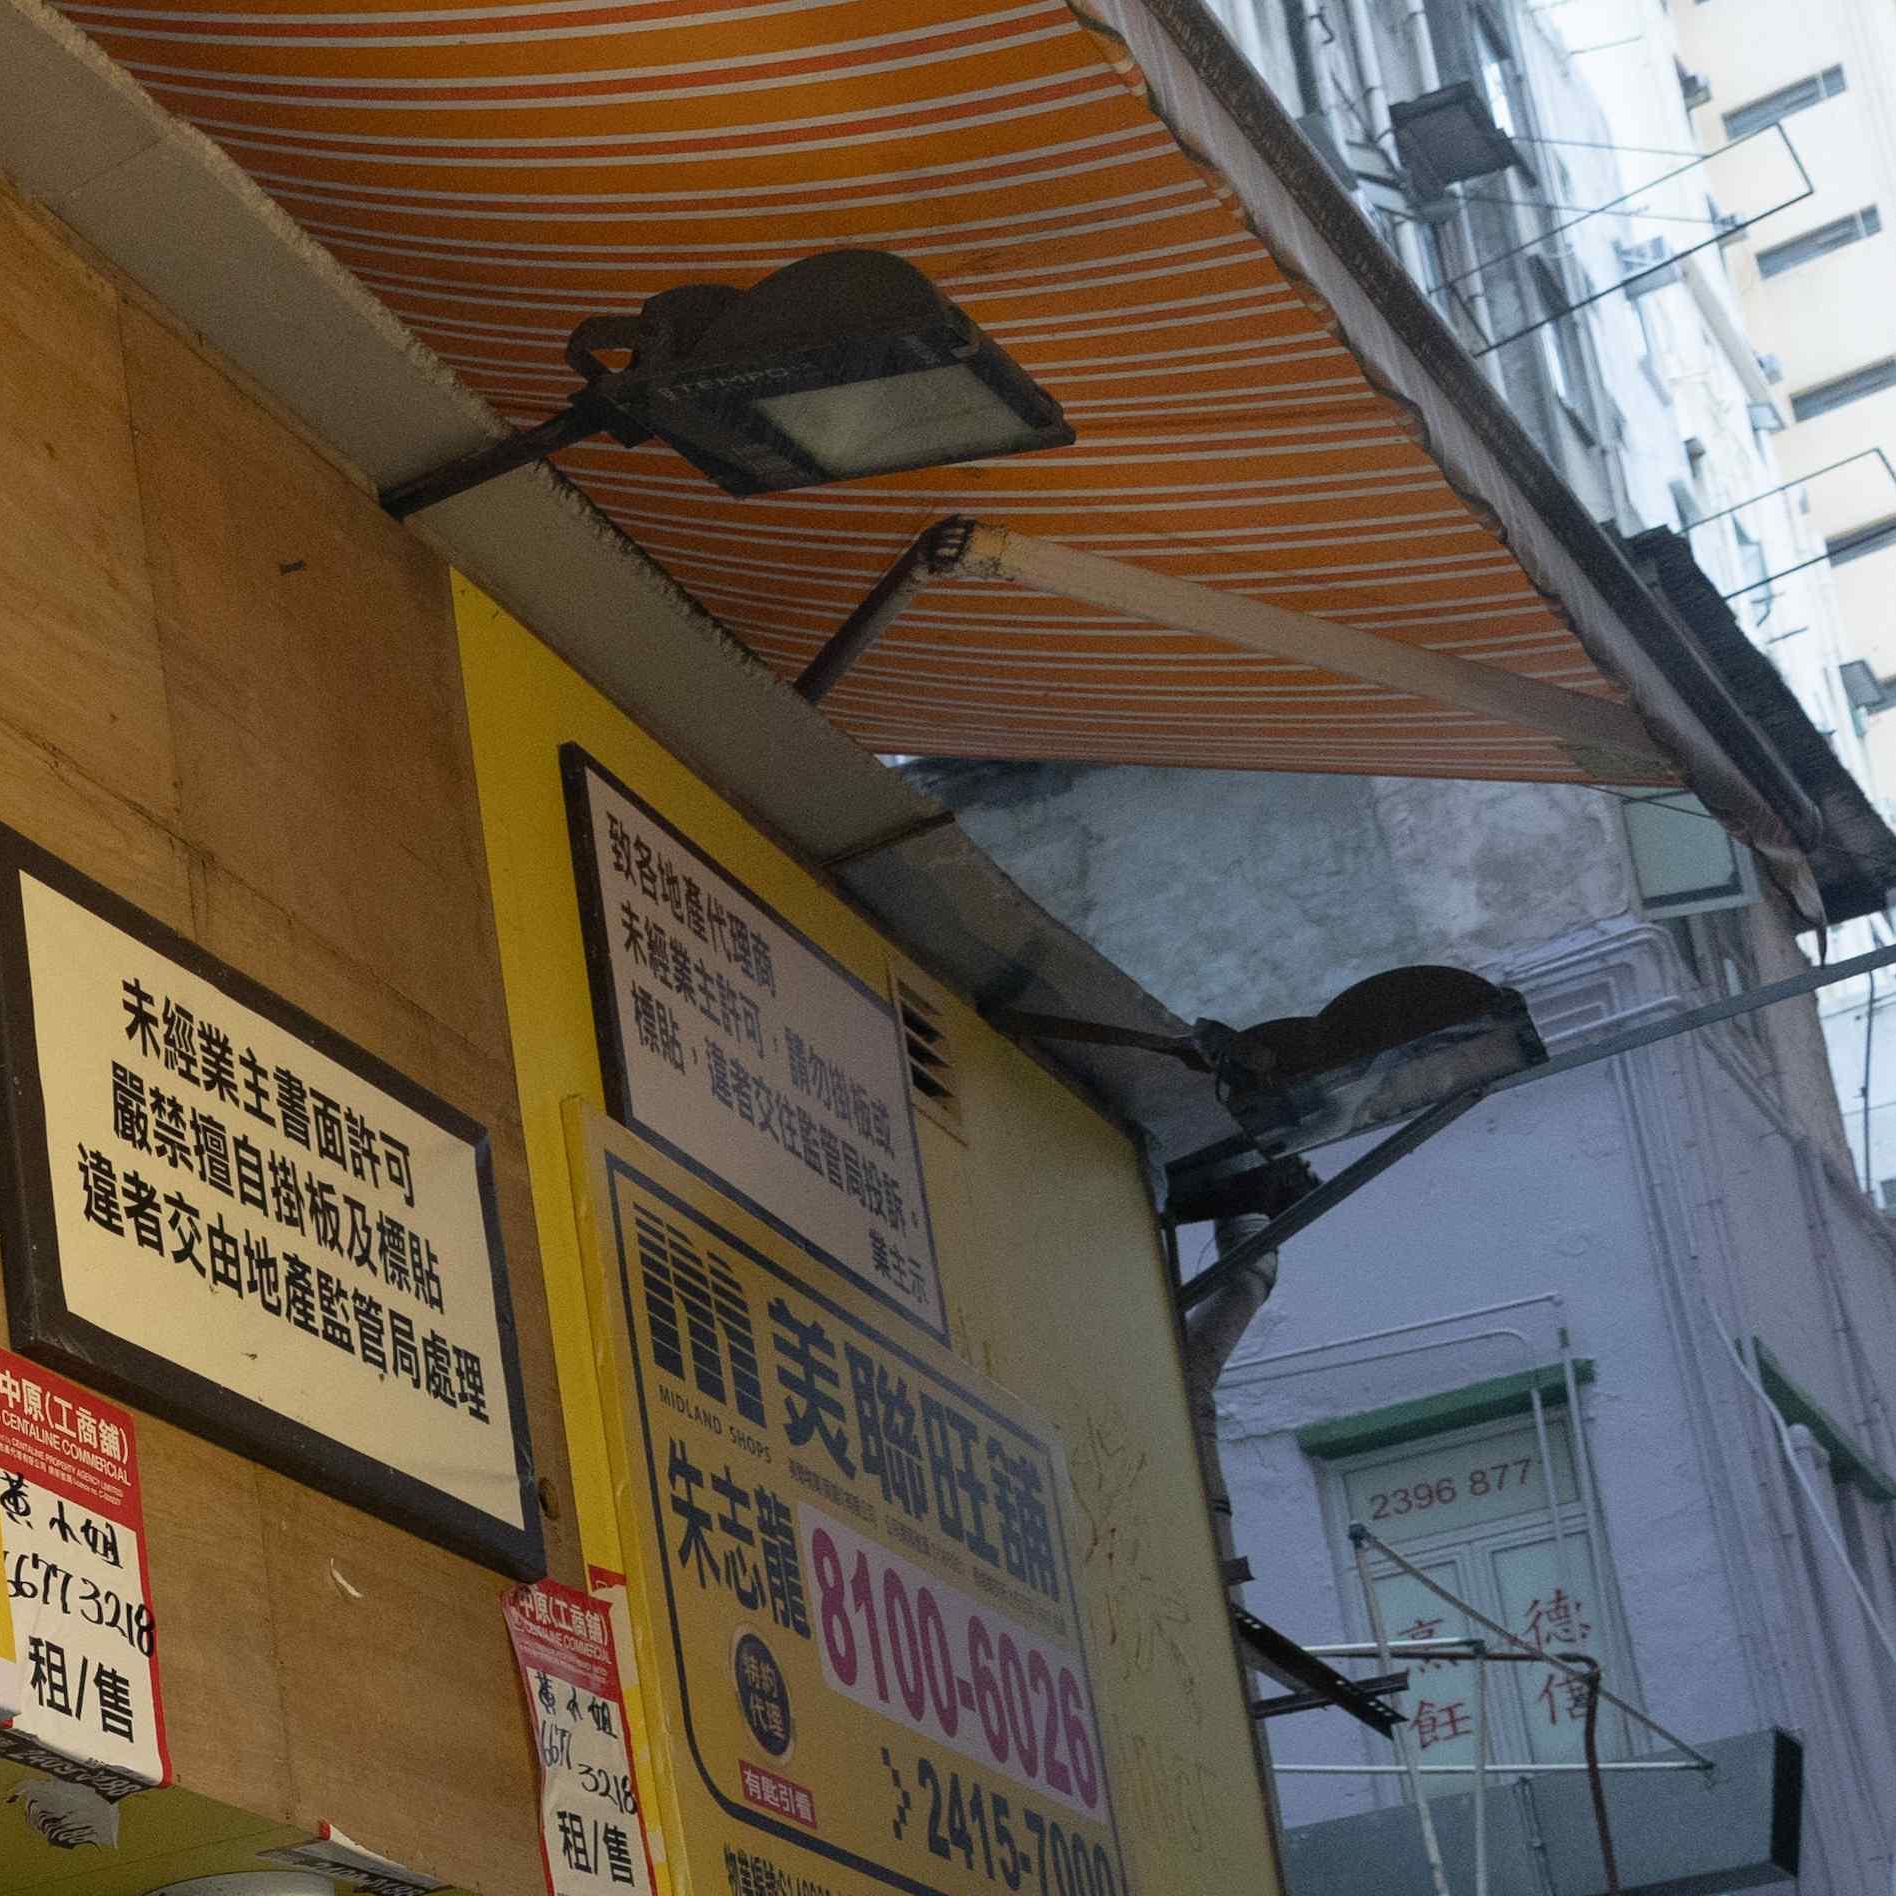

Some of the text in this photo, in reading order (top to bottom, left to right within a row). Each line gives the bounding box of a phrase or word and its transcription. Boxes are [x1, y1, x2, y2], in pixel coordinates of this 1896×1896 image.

[608, 811, 776, 997] 致各地產代理商
[111, 1061, 445, 1316] 嚴禁擅自掛板及標貼
[122, 977, 415, 1208] 未經業主書面許可
[77, 1142, 490, 1424] 違者交由地產監管局處理
[61, 1440, 131, 1487] COMMERCIAL
[768, 1298, 1060, 1602] 美聯旺舖
[1371, 1458, 1541, 1521] 2396 877
[79, 1578, 154, 1658] 3218
[813, 1528, 1097, 1809] 8100-6026
[578, 1763, 638, 1814] 3218
